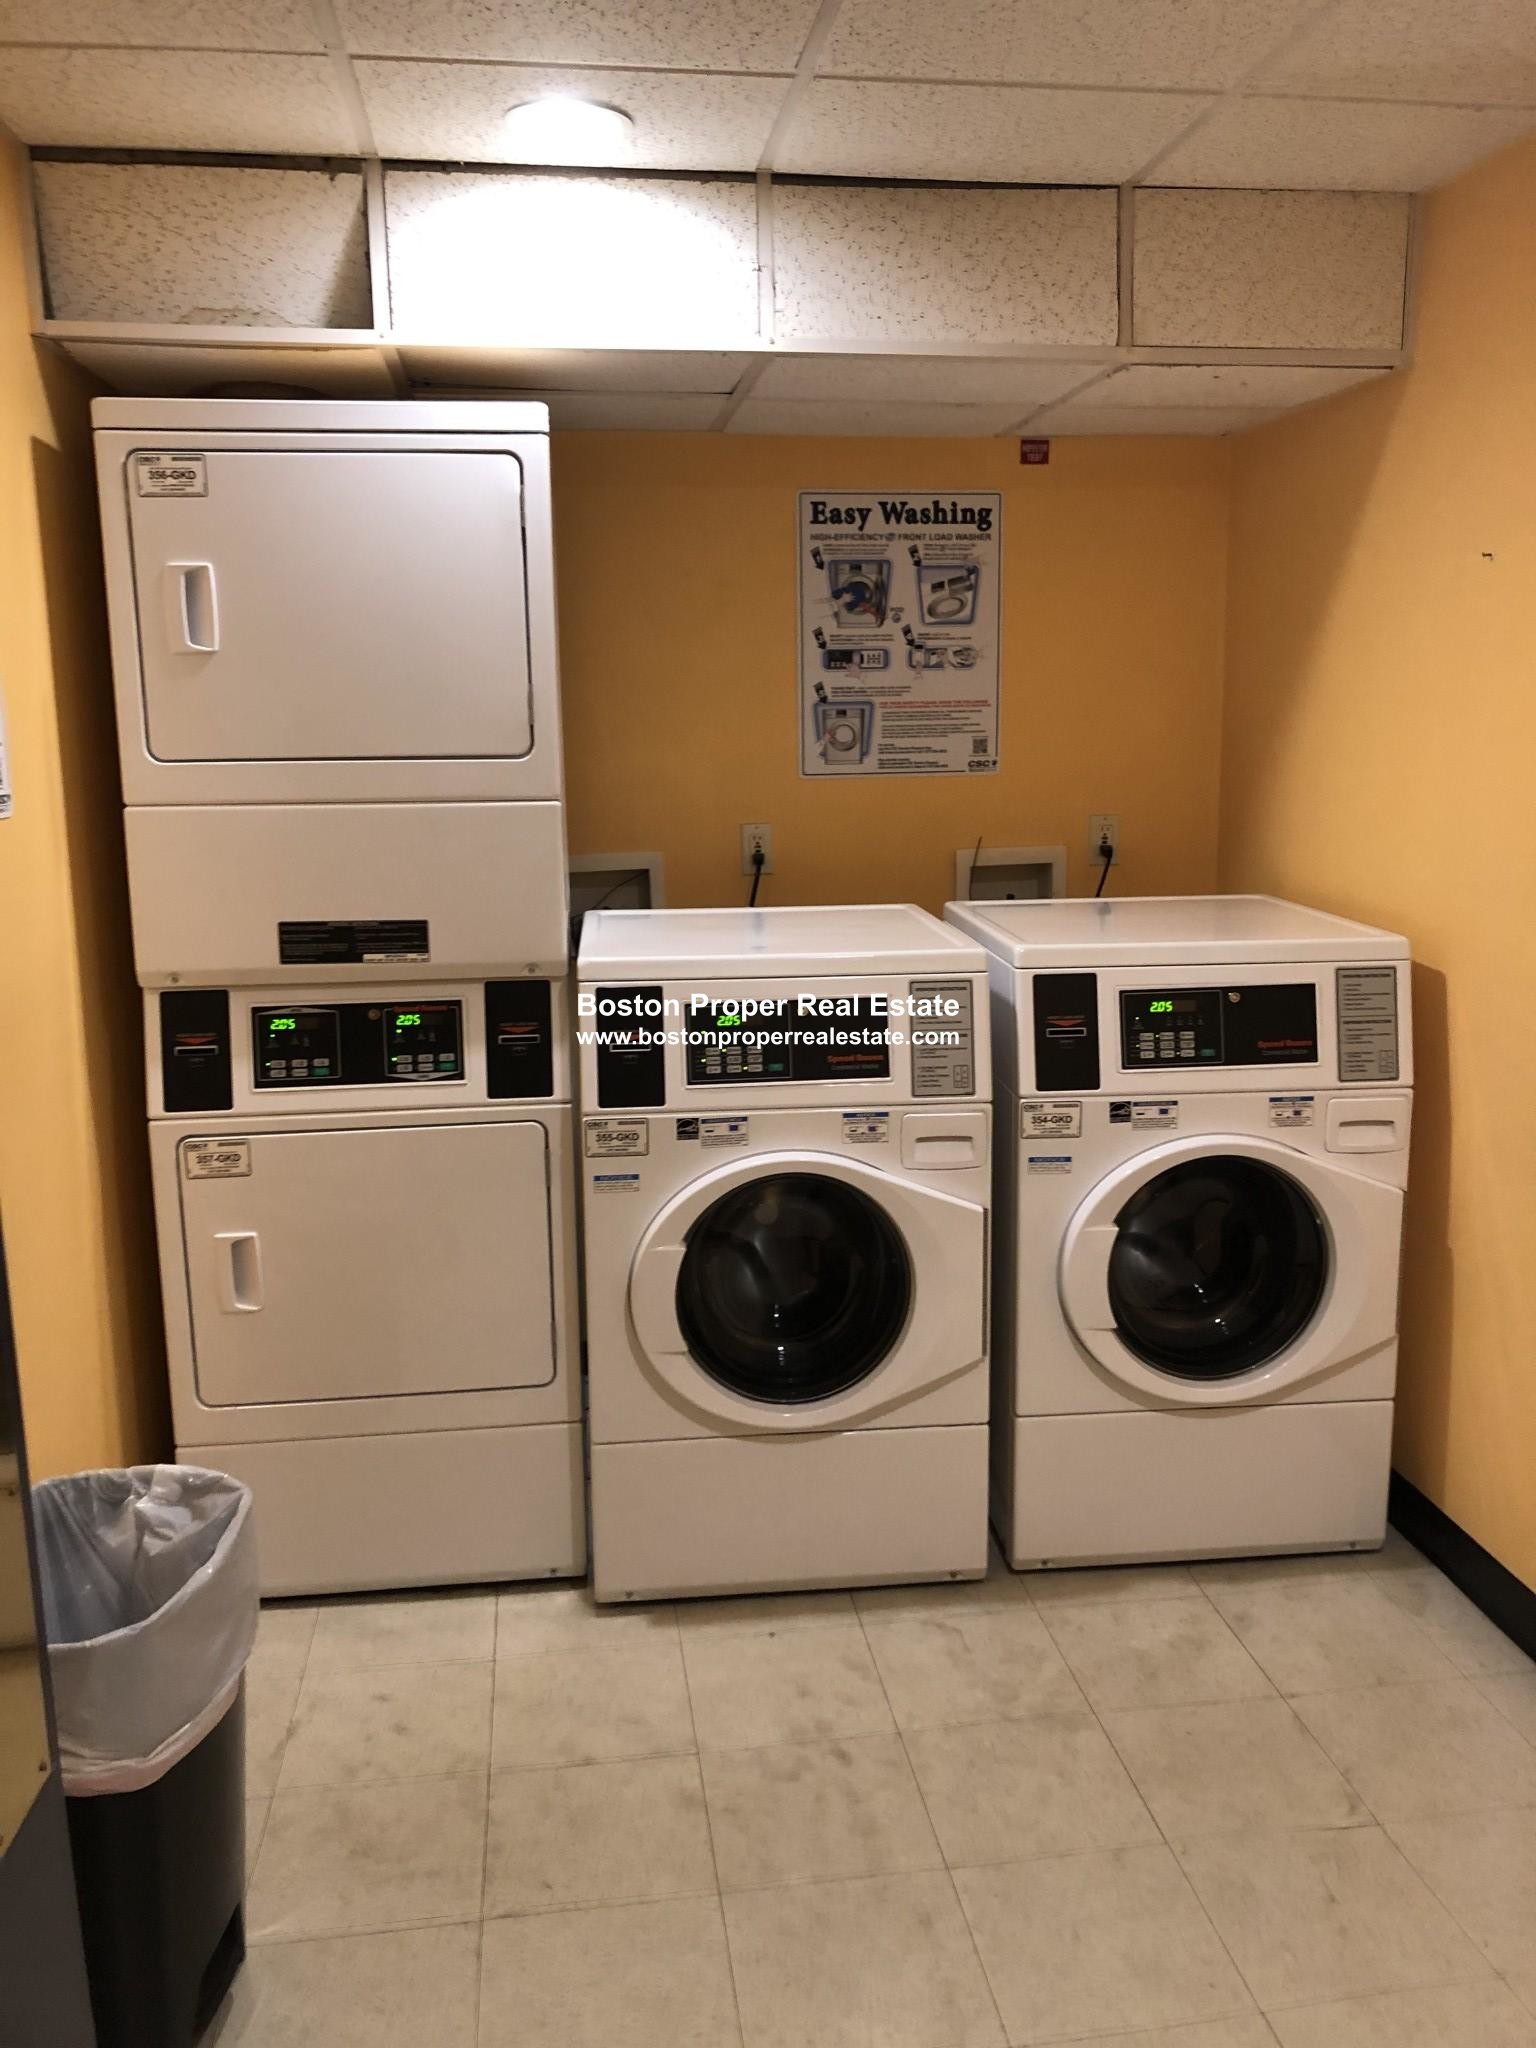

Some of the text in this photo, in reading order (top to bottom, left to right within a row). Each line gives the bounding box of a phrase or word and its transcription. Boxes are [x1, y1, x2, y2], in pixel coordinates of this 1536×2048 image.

[810, 500, 992, 531] Easy Washing
[809, 533, 992, 541] HIGH-EFFICIENCY FRONT LOAD WASHER
[968, 760, 990, 768] CSC
[1031, 1115, 1073, 1124] 354-GKD
[595, 1132, 640, 1142] 355-GKD
